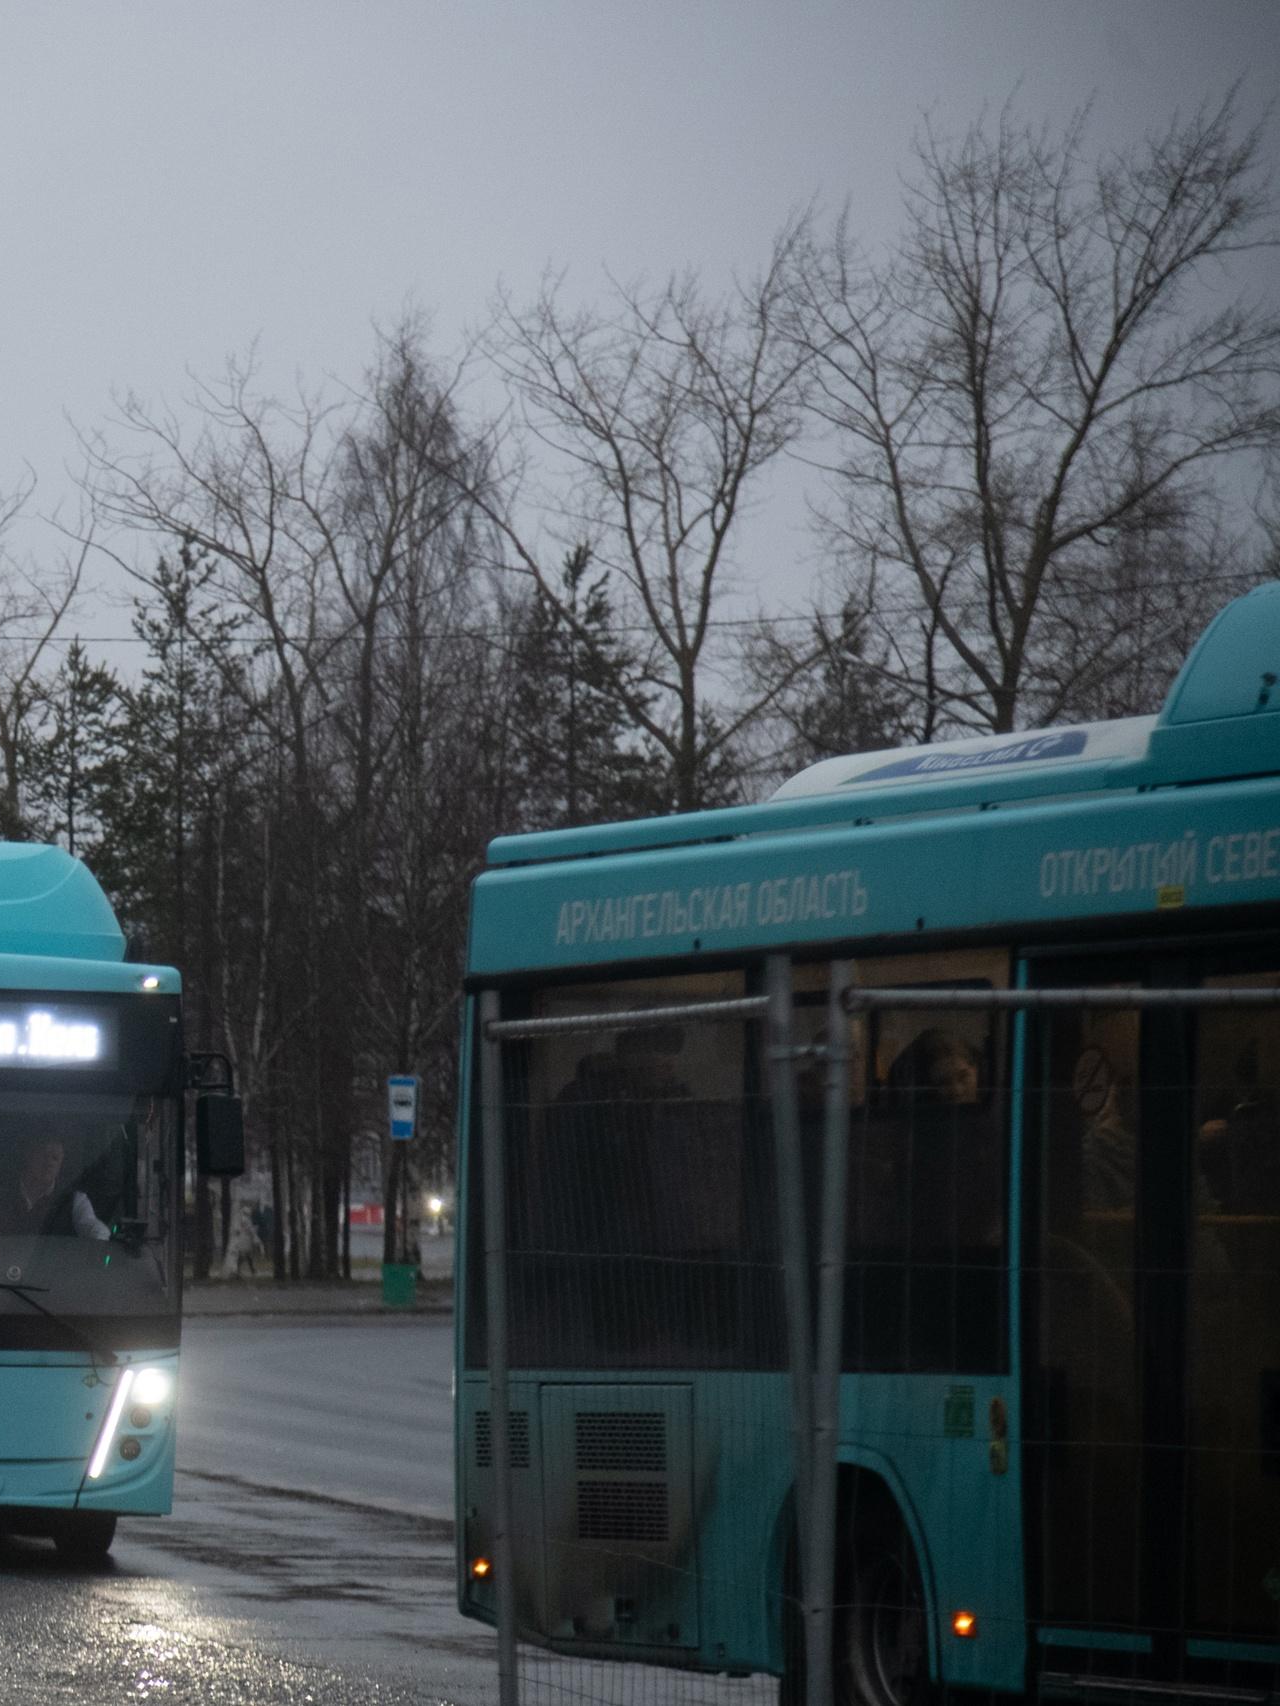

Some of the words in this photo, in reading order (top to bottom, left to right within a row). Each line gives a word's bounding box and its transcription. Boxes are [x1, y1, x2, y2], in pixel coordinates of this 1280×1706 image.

[1039, 830, 1198, 898] ОТКРЫТЫЙ
[556, 882, 751, 946] АРХАНГЕЛЬСКАЯ
[756, 869, 868, 927] ОБЛАСТЬ
